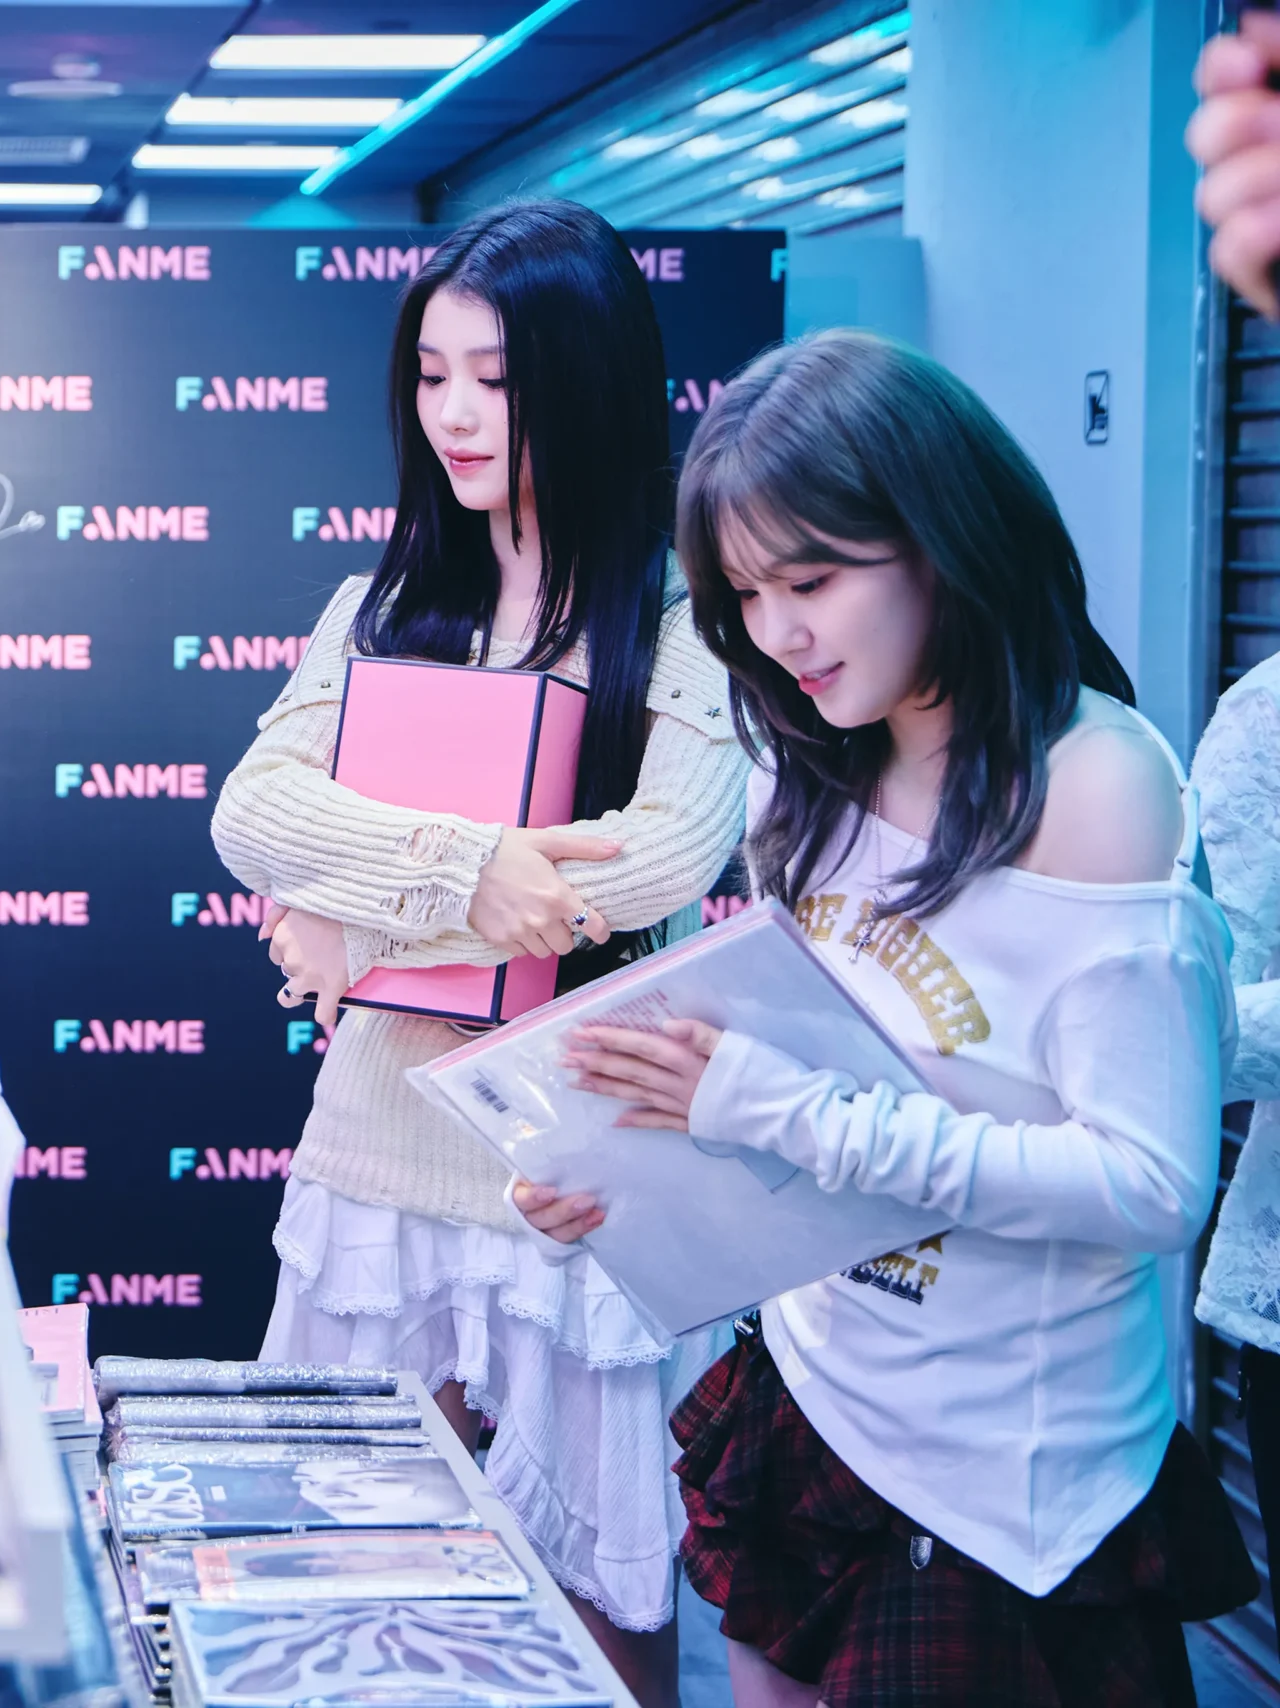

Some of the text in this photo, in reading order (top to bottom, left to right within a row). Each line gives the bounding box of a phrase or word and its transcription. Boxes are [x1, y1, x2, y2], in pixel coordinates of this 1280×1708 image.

[57, 245, 212, 282] FANME
[175, 376, 328, 412] FANME
[56, 505, 210, 541] FANME
[292, 506, 397, 542] FAN
[55, 763, 208, 799] FANME
[171, 892, 274, 927] FAN
[54, 1019, 205, 1054] FANME
[169, 1147, 292, 1180] FANM
[52, 1273, 203, 1307] FANME
